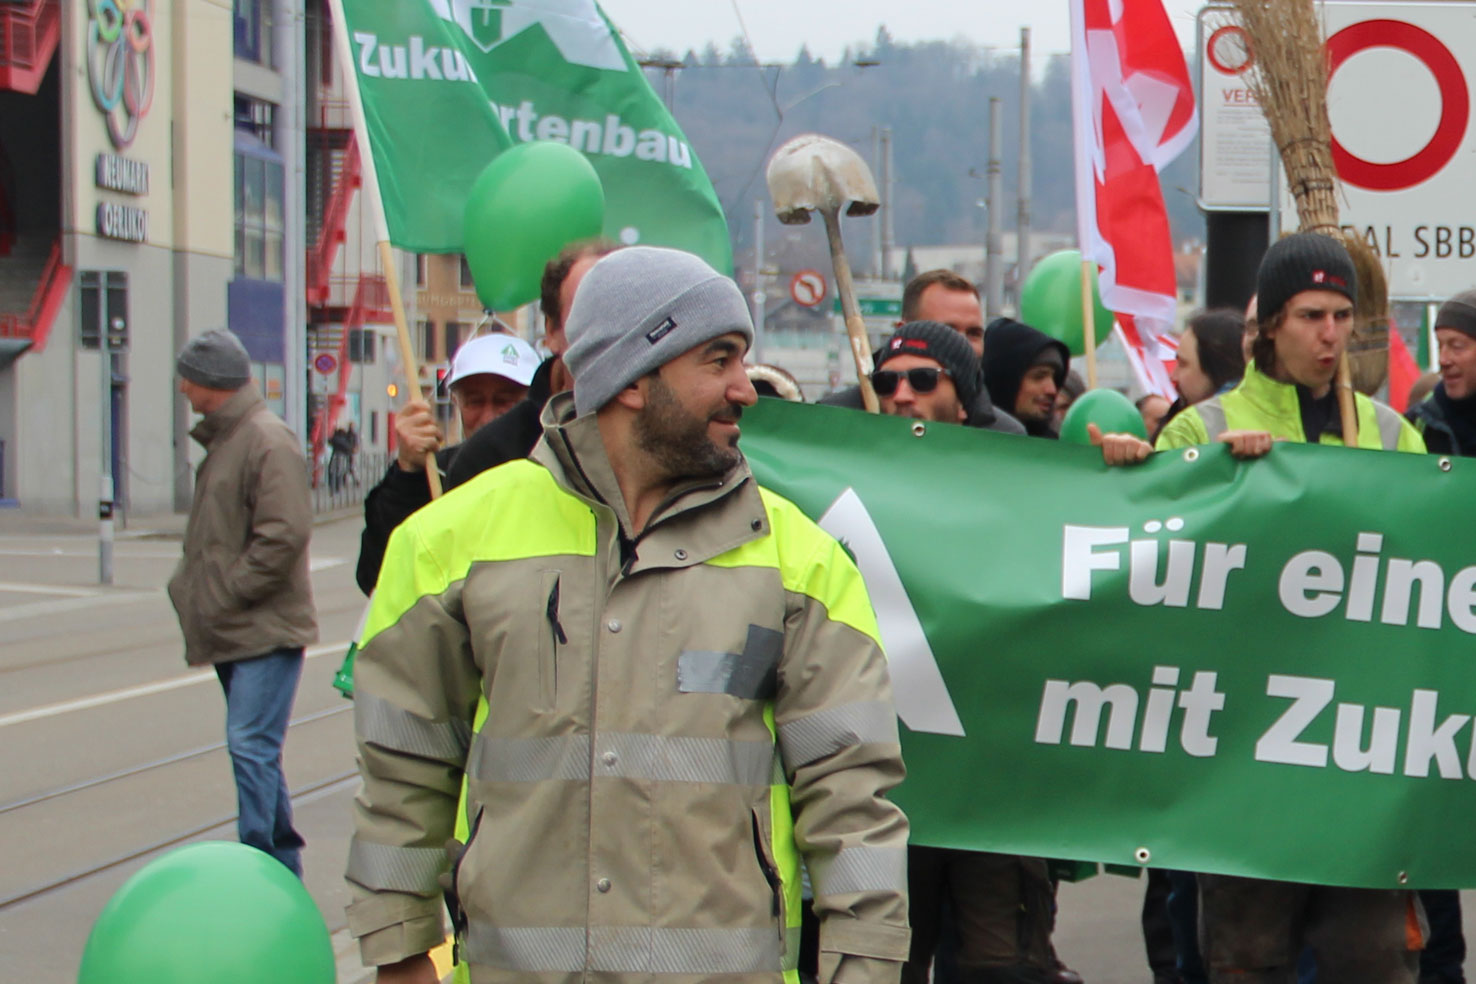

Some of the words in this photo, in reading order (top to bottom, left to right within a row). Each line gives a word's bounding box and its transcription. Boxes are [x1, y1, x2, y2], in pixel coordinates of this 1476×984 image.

[1414, 225, 1476, 259] SBB
[1062, 517, 1247, 611] Für
[1034, 665, 1226, 758] mit
